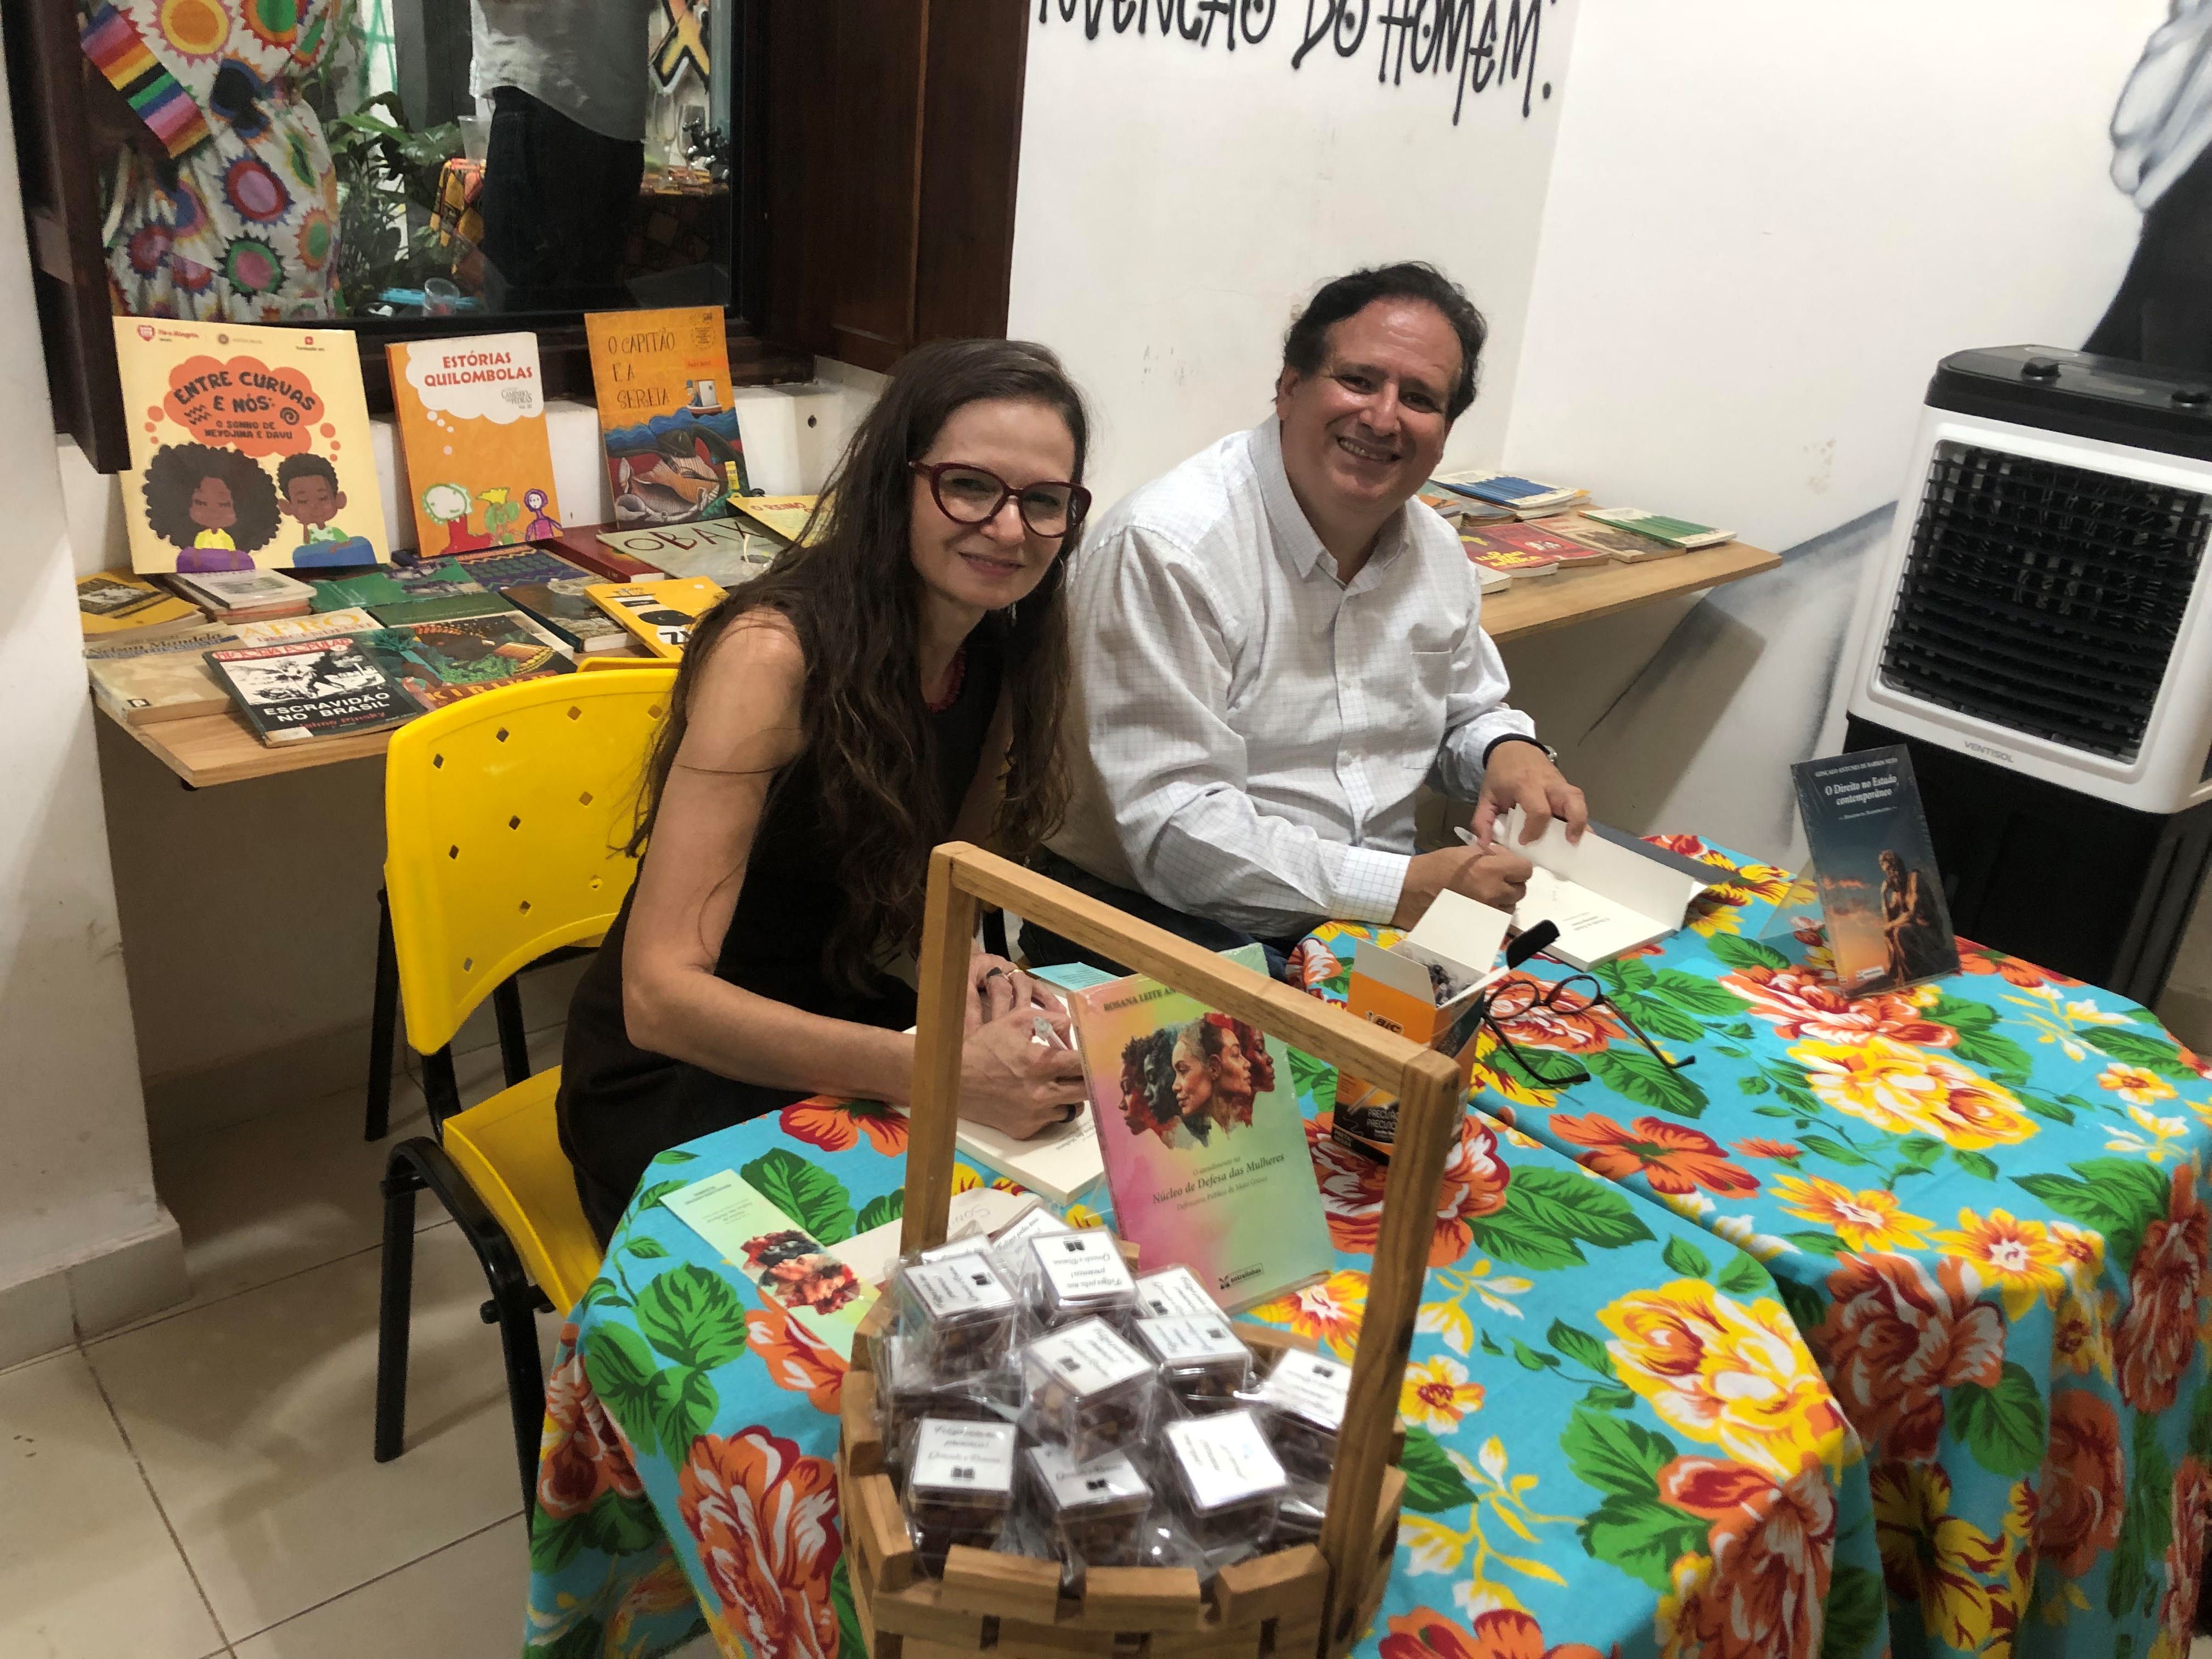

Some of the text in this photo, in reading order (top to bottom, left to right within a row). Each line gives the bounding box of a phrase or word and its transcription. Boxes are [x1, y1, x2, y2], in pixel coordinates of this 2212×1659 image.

[1291, 0, 1370, 69] DO
[608, 336, 617, 354] O
[622, 328, 675, 354] CAPITÃO
[442, 350, 511, 369] ESTÓRIAS
[424, 366, 533, 387] QUILOMBOLAS
[613, 363, 635, 381] E A
[173, 371, 232, 404] ENTRE
[617, 387, 670, 409] SEREIA
[213, 396, 225, 411] E
[227, 421, 258, 430] SONHO
[263, 421, 276, 430] DE
[764, 502, 807, 511] REINO
[242, 614, 360, 638] AFRO
[89, 645, 144, 654] Nelson
[150, 633, 221, 647] Mandela
[263, 692, 390, 715] ESCRAVIDÃO
[277, 713, 308, 722] NO
[319, 701, 390, 717] BRASIL
[340, 712, 385, 724] Pinsky
[1965, 741, 2014, 763] VENTISOL
[1825, 786, 1832, 795] O
[1833, 782, 1860, 794] Direito
[1872, 774, 1897, 786] Estado
[1836, 788, 1892, 805] contemporâneo
[1103, 996, 1138, 1011] ROSANA
[1139, 989, 1163, 1002] LEITE
[1153, 1154, 1285, 1204] Núcleo de Defesa das Mulheres
[1231, 1267, 1261, 1283] entrelinhas
